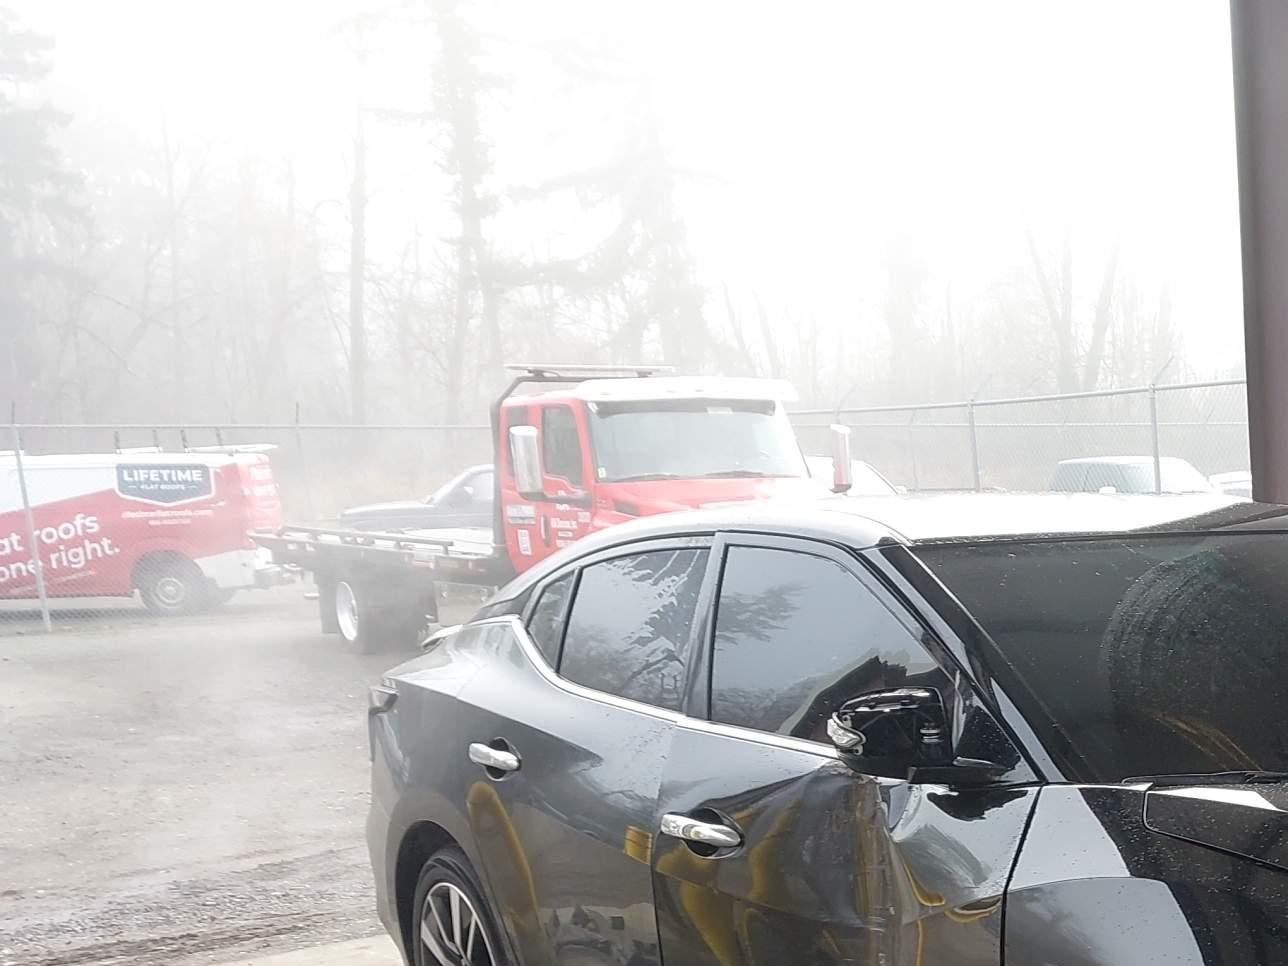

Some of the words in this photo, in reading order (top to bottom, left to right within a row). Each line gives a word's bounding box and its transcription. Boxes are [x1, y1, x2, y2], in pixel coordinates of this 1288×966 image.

[123, 469, 203, 482] LIFETIME
[33, 513, 100, 544] roofs
[49, 537, 121, 569] right.
